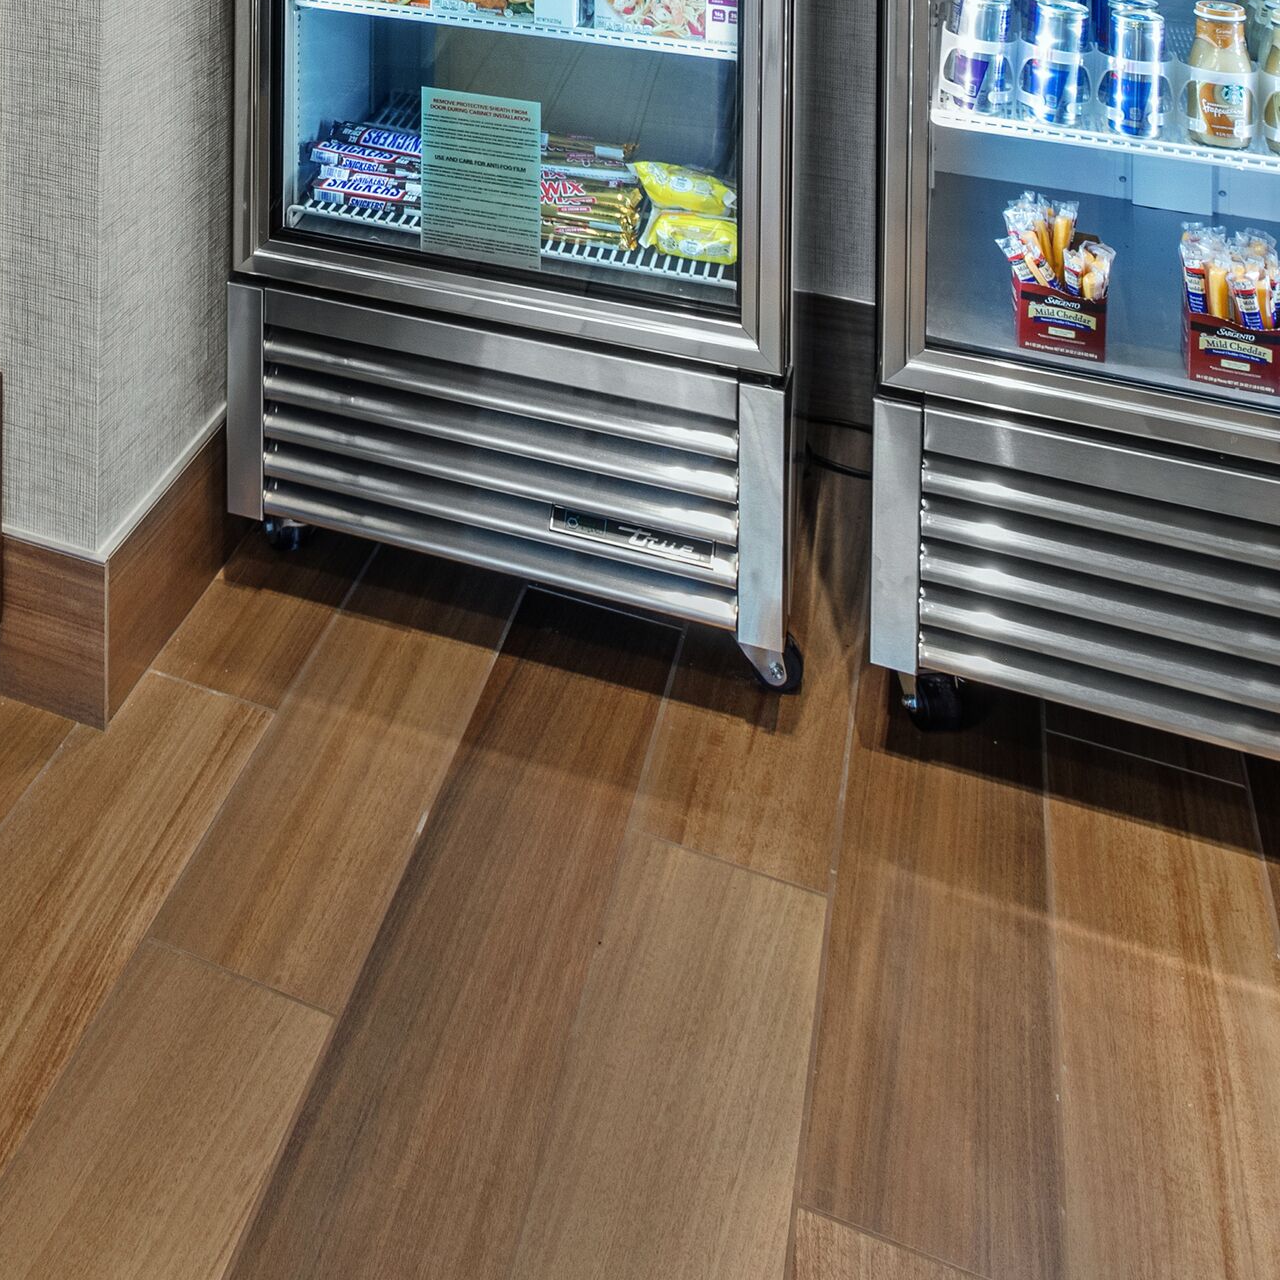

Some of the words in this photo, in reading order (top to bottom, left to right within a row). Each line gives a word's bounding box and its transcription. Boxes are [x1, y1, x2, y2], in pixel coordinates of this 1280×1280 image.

[433, 98, 455, 106] REMOVE
[456, 102, 489, 110] PROTECTIVE
[469, 109, 492, 117] CABINET
[493, 113, 530, 122] INSTALLATION
[343, 159, 376, 171] SNICKERS
[1045, 296, 1080, 309] SARGENTO
[1035, 308, 1055, 316] Mild
[1057, 310, 1091, 325] Cheddar
[1217, 328, 1255, 341] SARGENTO
[1206, 339, 1228, 349] Mild
[1229, 342, 1267, 357] Cheddar
